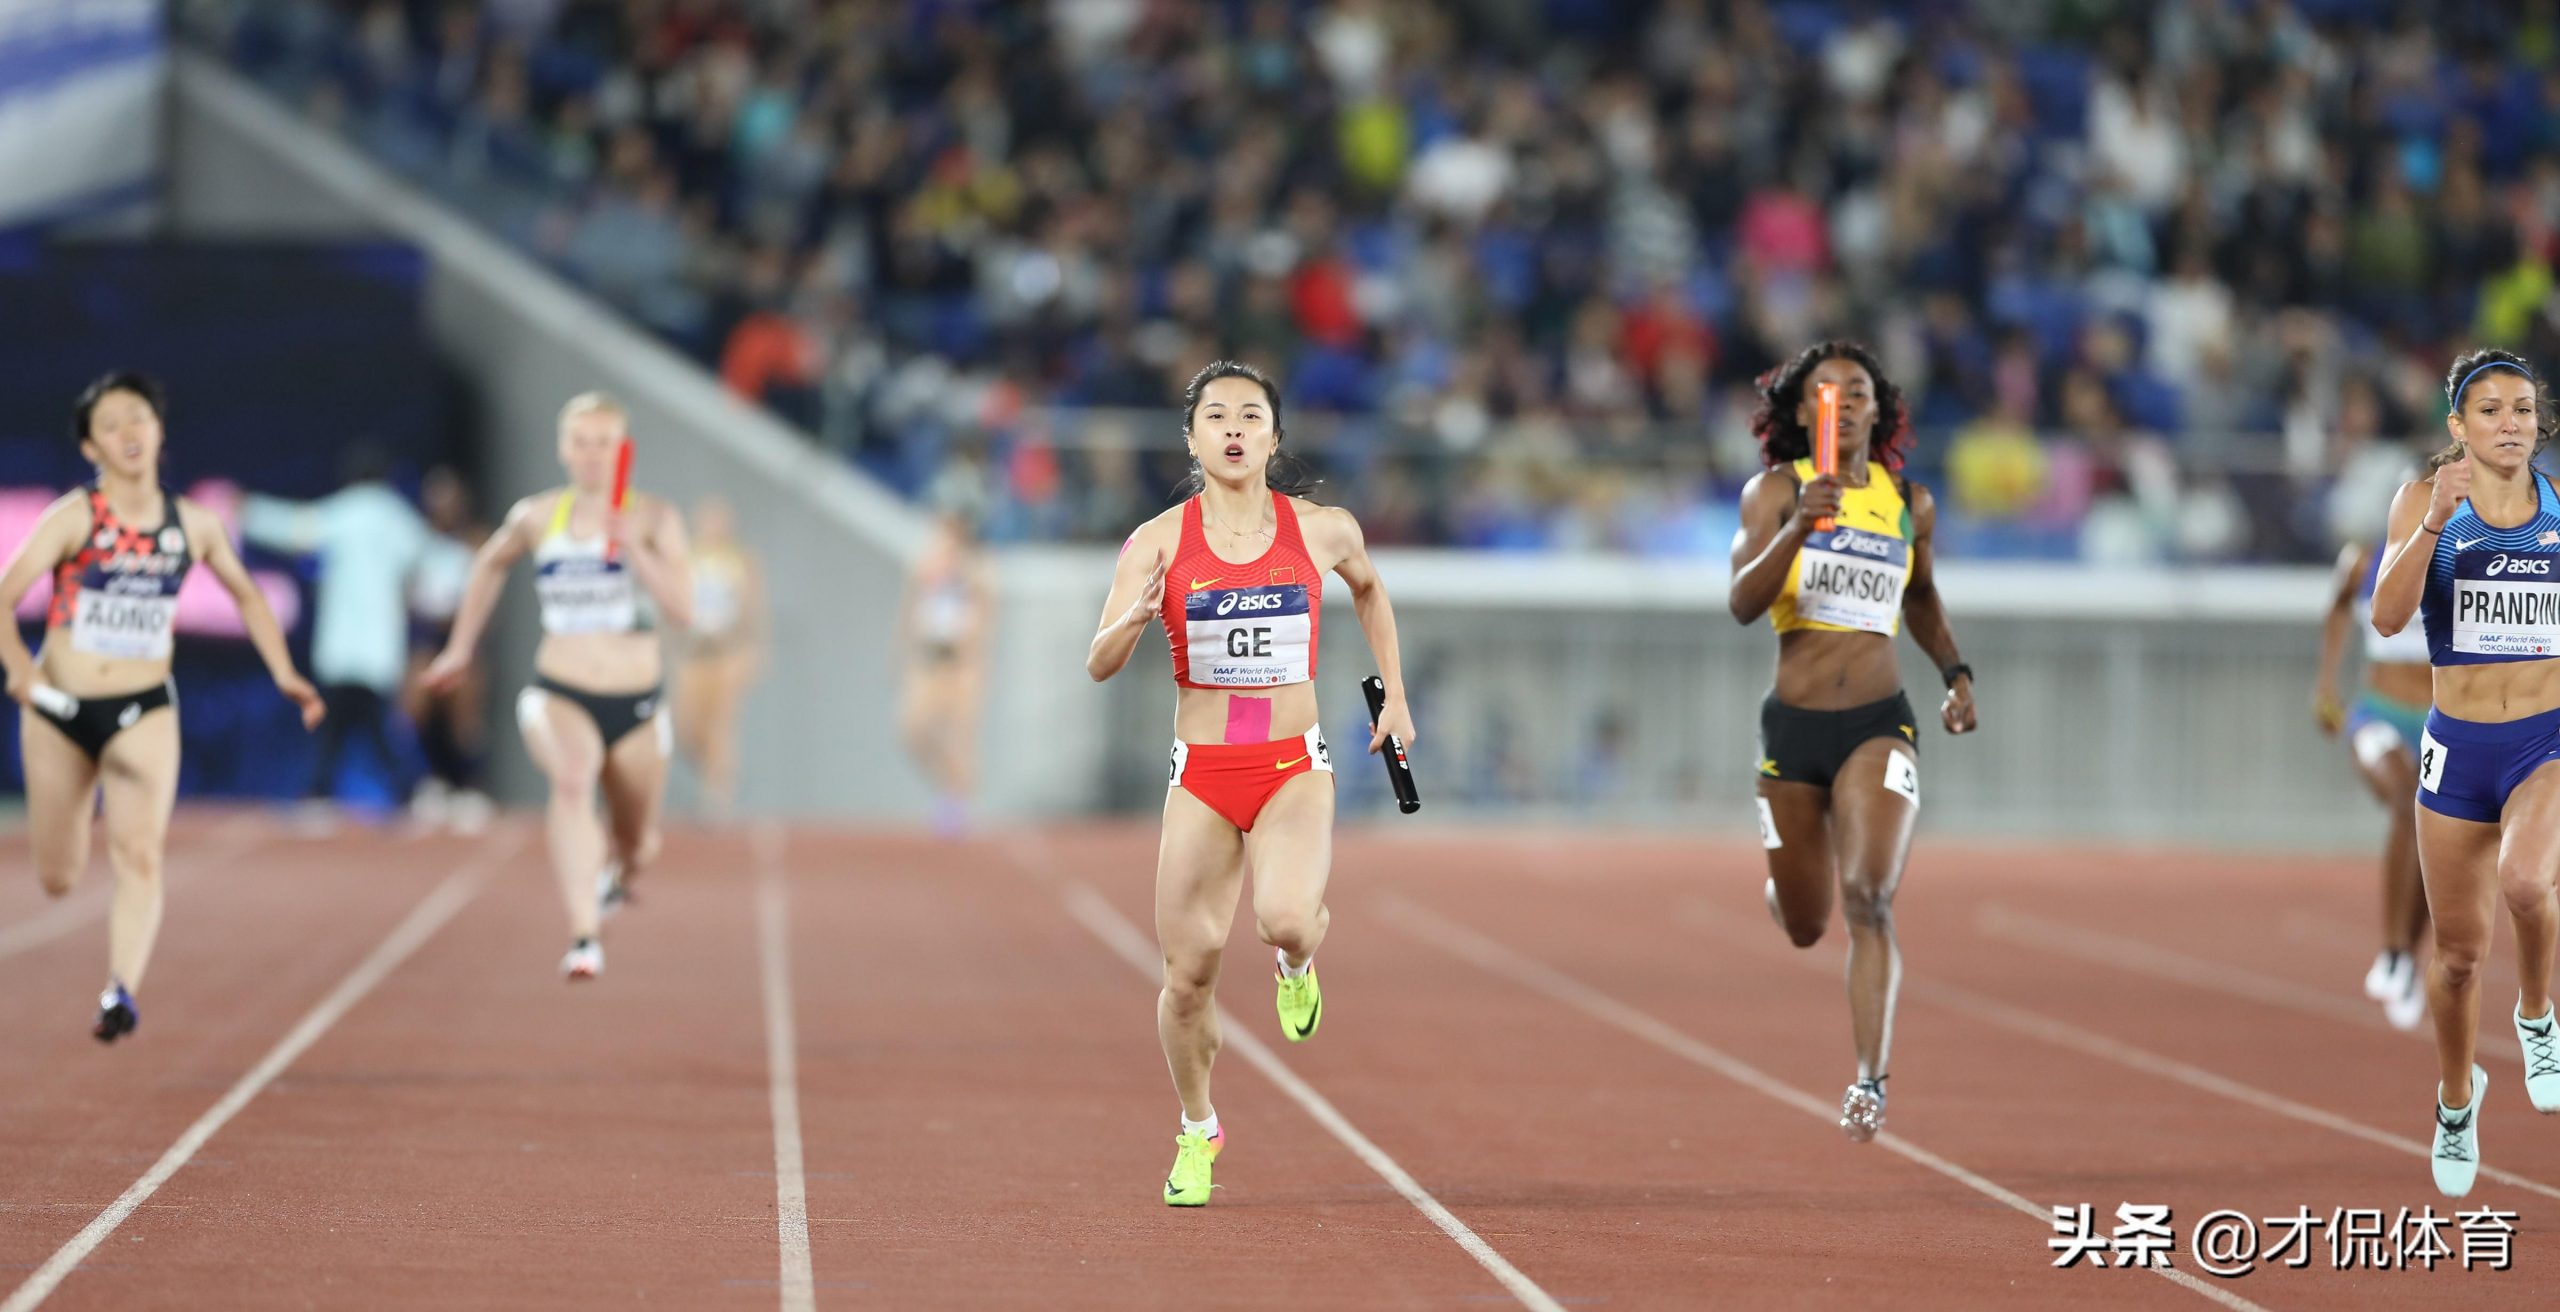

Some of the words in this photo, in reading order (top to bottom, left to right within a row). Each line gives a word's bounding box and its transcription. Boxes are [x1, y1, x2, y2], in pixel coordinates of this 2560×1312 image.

[2506, 558, 2551, 575] asics
[1804, 561, 1900, 606] JACKSON
[1238, 593, 1282, 611] asics
[1227, 627, 1272, 658] GE
[2478, 634, 2503, 642] IAAF
[2504, 635, 2527, 643] World
[2528, 636, 2552, 645] Relays
[2478, 644, 2529, 653] YOKOHAMA
[1213, 667, 1238, 675] IAAF
[1239, 667, 1262, 675] World
[1263, 666, 1288, 676] Relays
[1213, 676, 1264, 685] YOKOHAMA
[2422, 747, 2434, 780] 4
[1902, 767, 1915, 794] 5
